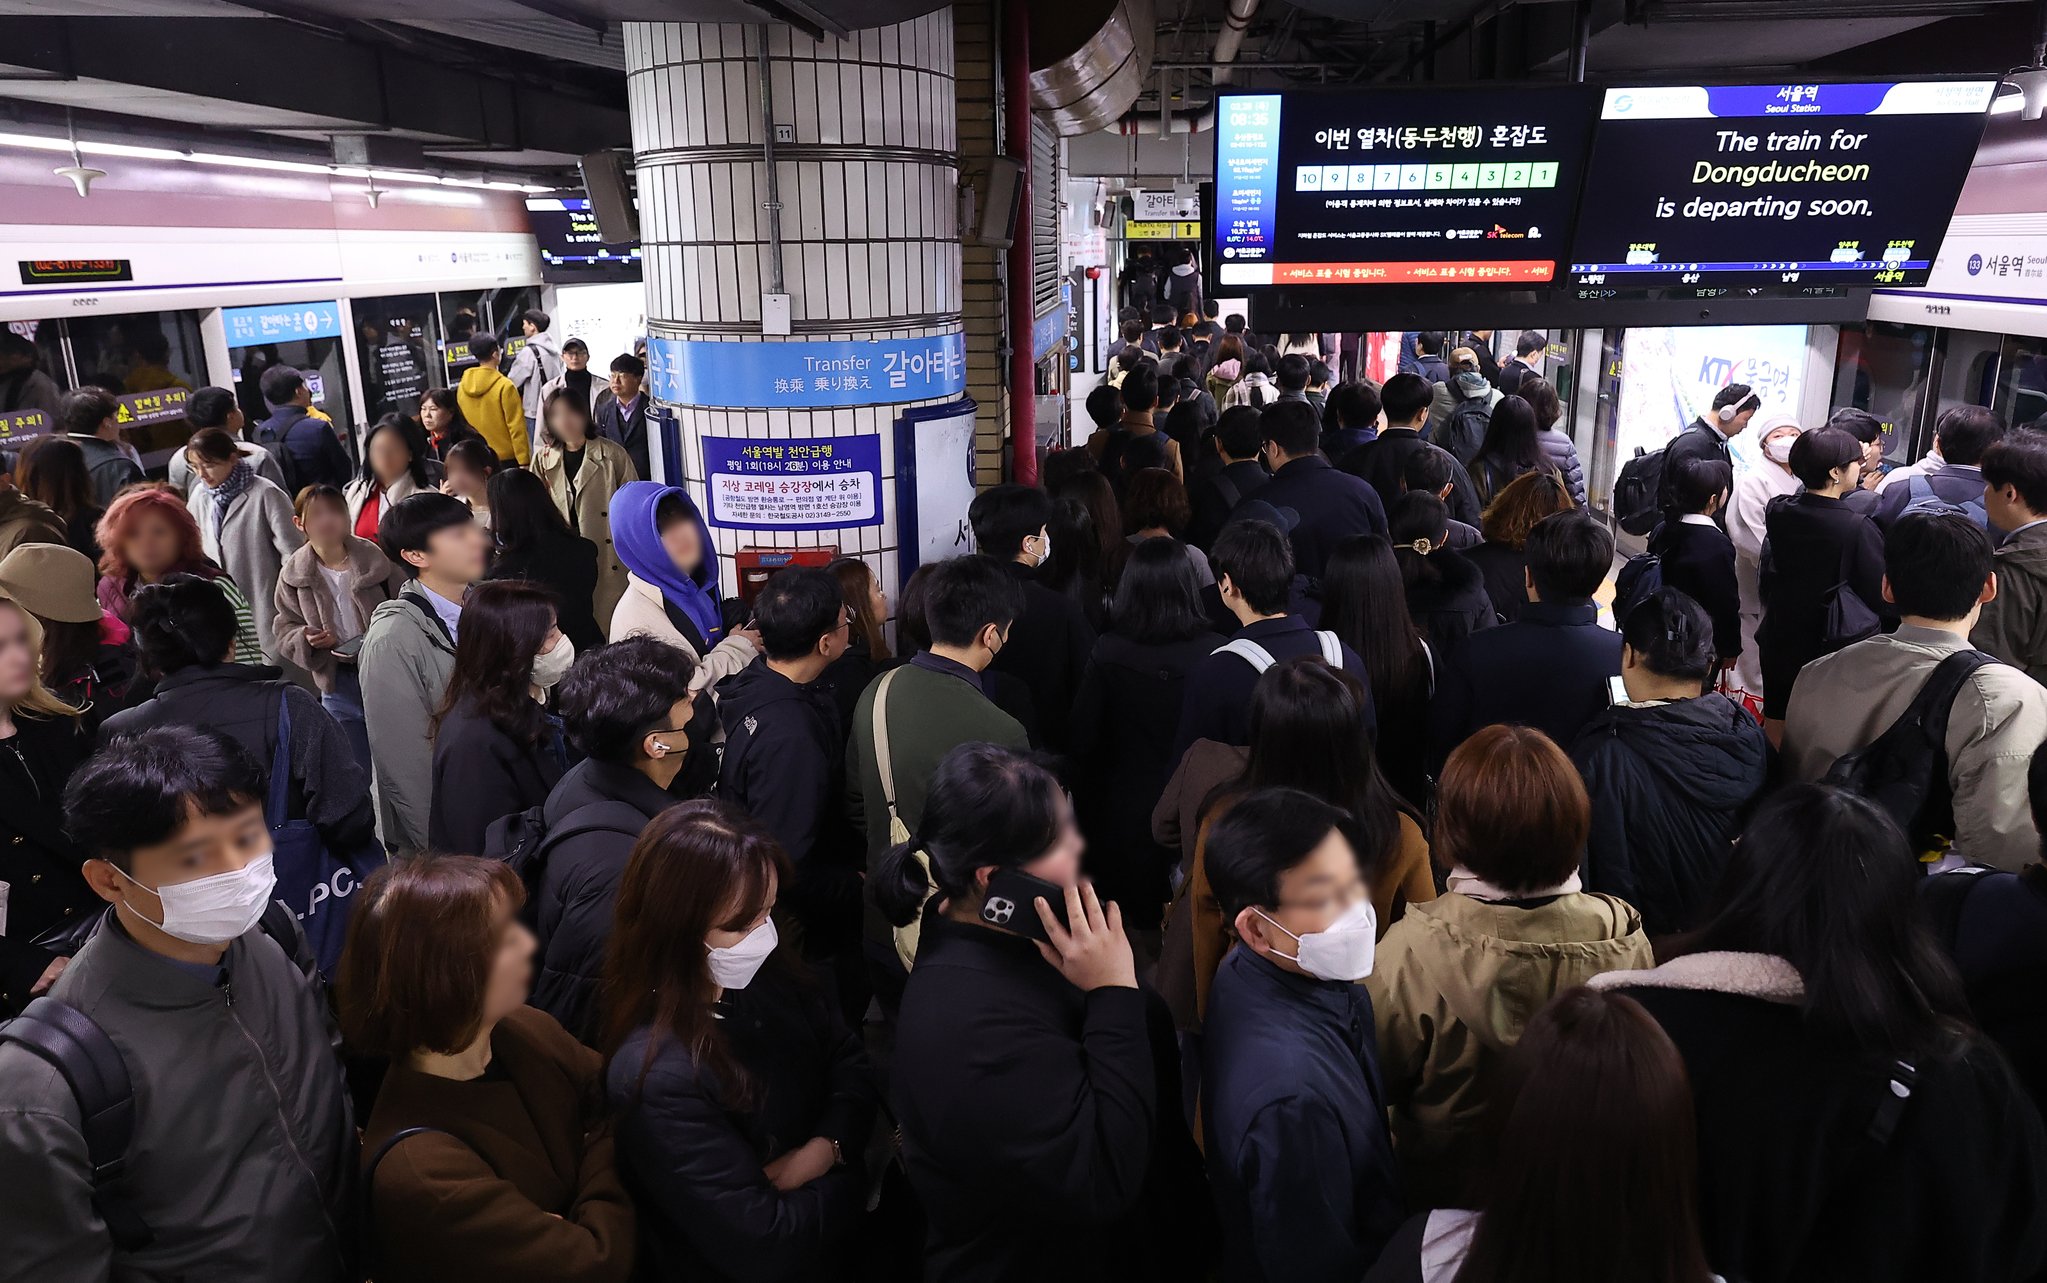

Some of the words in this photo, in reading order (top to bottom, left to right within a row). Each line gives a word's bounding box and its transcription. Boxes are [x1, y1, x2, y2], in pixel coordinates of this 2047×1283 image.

[1777, 85, 1819, 102] 서울역
[1765, 104, 1788, 114] Seoul
[1790, 103, 1821, 113] Station
[1230, 113, 1269, 126] 08:35
[778, 129, 790, 139] 11
[1315, 128, 1350, 150] 이번
[1357, 126, 1483, 149] 열차(동두천행)
[1490, 125, 1548, 147] 혼잡도
[1715, 130, 1758, 152] The
[1767, 130, 1821, 151] train
[1829, 128, 1868, 149] for
[1302, 173, 1317, 184] 10
[1331, 173, 1339, 183] 9
[1357, 173, 1365, 183] 8
[1384, 172, 1391, 182] 7
[1409, 172, 1417, 182] 6
[1435, 172, 1443, 182] 5
[1461, 171, 1469, 181] 4
[1487, 171, 1495, 181] 3
[1514, 171, 1522, 181] 2
[1541, 170, 1547, 180] 1
[1692, 160, 1869, 187] Dongducheon
[1146, 194, 1175, 208] 갈아타
[1656, 197, 1676, 218] is
[1682, 196, 1799, 221] departing
[1808, 198, 1873, 217] soon.
[1290, 269, 1313, 277] 서비스
[1353, 269, 1387, 278] 중입니다.
[1414, 268, 1437, 276] 서비스
[1477, 267, 1511, 277] 중입니다.
[1969, 259, 1981, 270] 133
[1986, 255, 2023, 277] 서울역
[1874, 271, 1905, 282] 서울역
[804, 355, 871, 372] Transfer
[883, 349, 961, 389] 갈아타는
[1699, 355, 1744, 388] KTX
[774, 378, 804, 394] 换乘
[814, 376, 872, 392] 乗り換え
[15, 413, 43, 429] 주의!
[1880, 422, 1893, 436] 의!
[742, 446, 784, 459] 서울역발
[788, 445, 833, 459] 천안급행
[726, 460, 742, 471] 평일
[745, 460, 782, 471] 1회(18시
[812, 459, 830, 471] 이용
[833, 458, 852, 470] 안내
[722, 480, 741, 493] 지상
[744, 480, 775, 494] 코레일
[778, 479, 835, 494] 승강장에서
[838, 477, 861, 492] 승차
[813, 502, 828, 510] 1호선
[732, 511, 749, 519] 자세한
[768, 512, 804, 520] 한국철도공사
